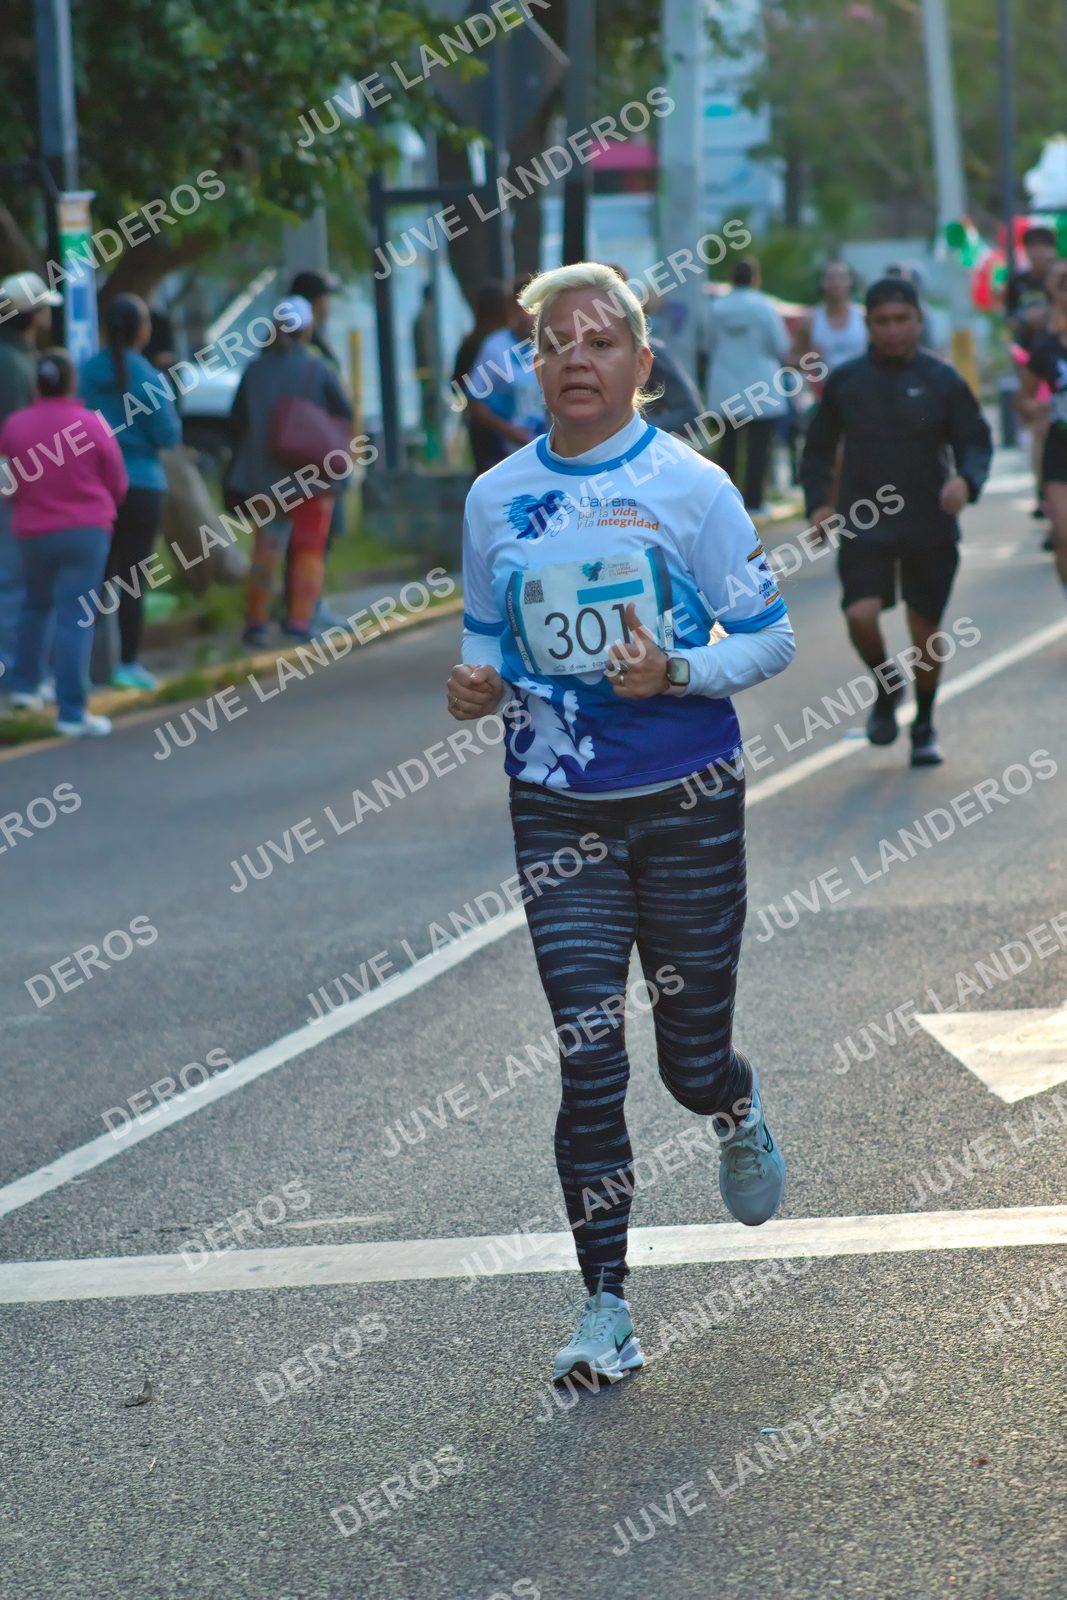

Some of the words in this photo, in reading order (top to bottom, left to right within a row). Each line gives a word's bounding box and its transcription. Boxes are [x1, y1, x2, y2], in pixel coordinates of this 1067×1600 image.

[611, 508, 638, 517] Vida
[597, 517, 660, 531] Integridad
[544, 603, 631, 660] 301
